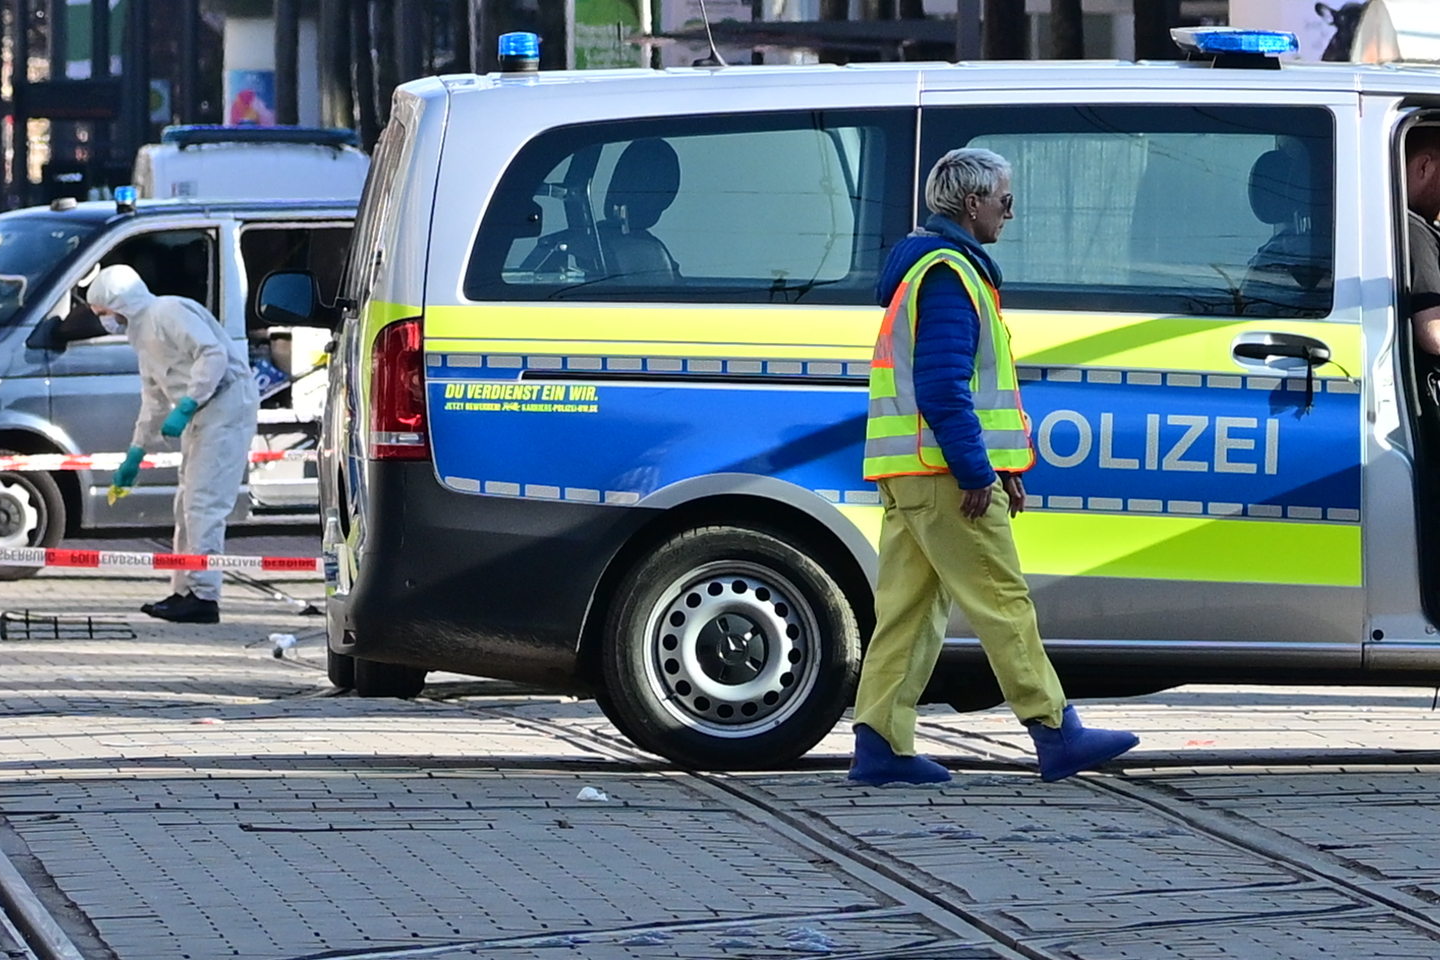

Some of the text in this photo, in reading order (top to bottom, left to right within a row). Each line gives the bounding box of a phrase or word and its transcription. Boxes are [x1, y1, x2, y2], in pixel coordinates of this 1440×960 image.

[444, 383, 599, 401] DU VERDIENST EIN WIR.
